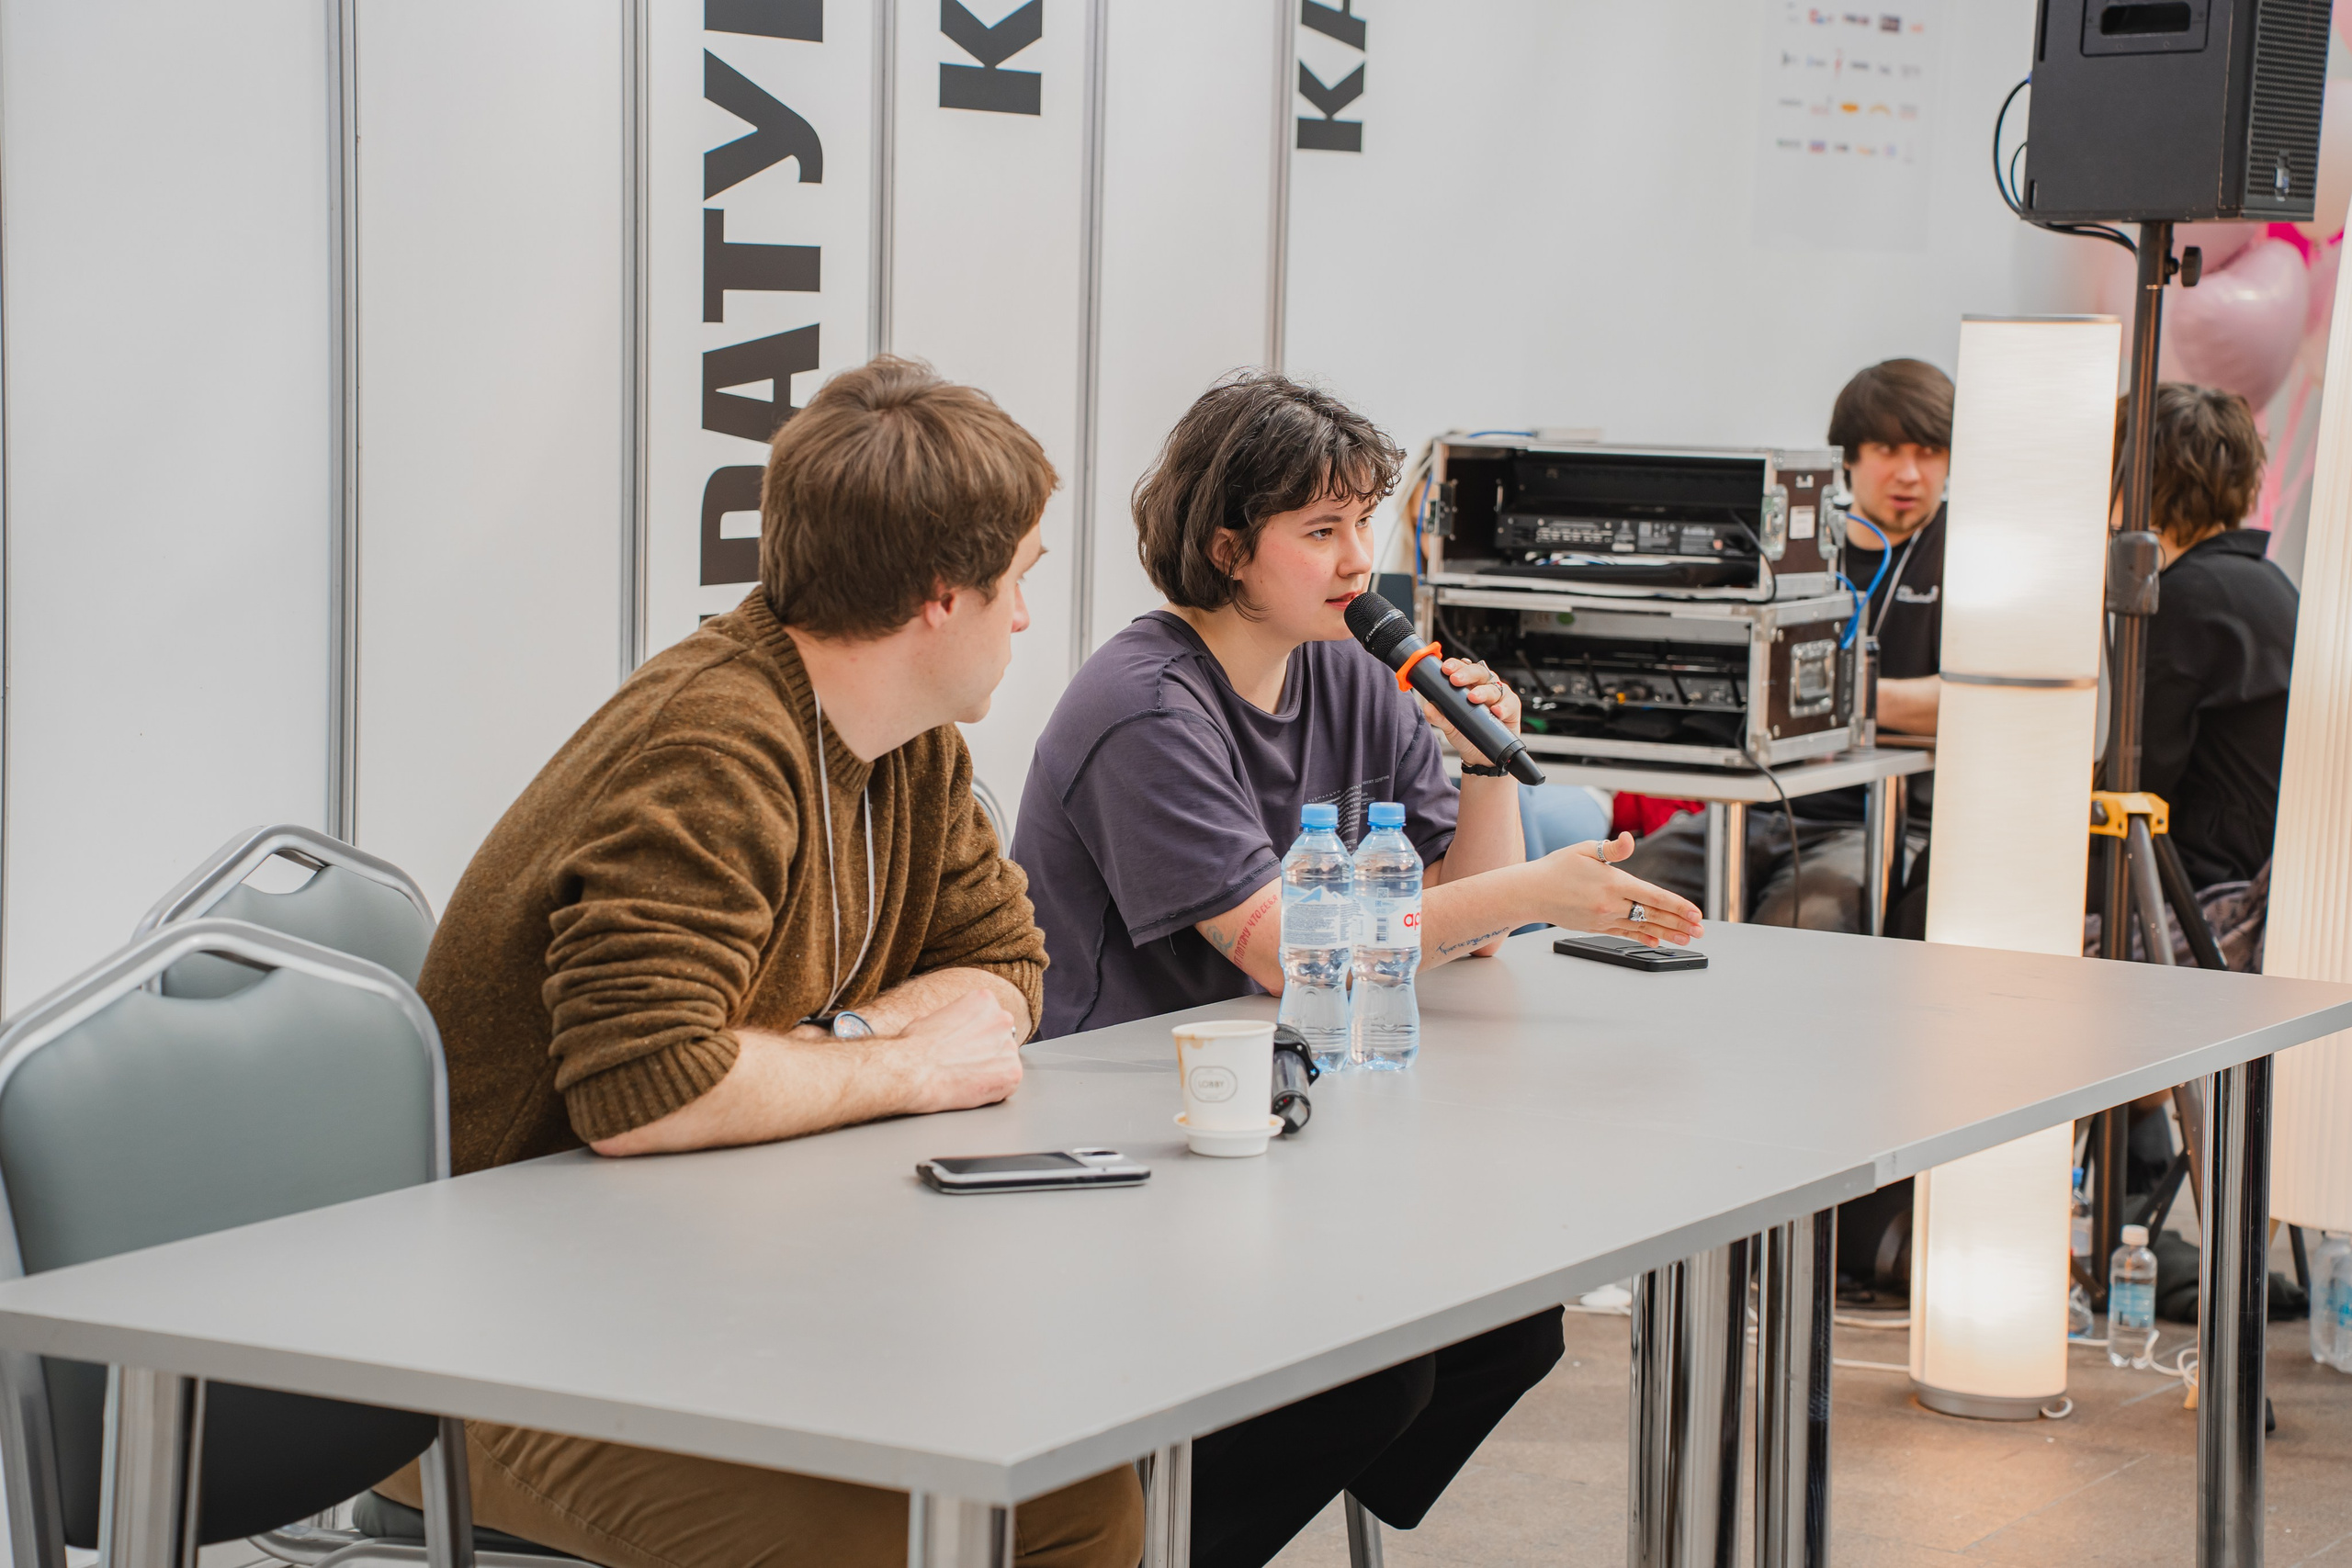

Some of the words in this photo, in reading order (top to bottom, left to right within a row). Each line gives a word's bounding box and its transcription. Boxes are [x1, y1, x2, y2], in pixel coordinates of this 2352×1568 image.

[1247, 909, 1261, 927] ЧТО
[1260, 895, 1279, 914] СЕБЯ
[1198, 1079, 1225, 1089] LOBBY
